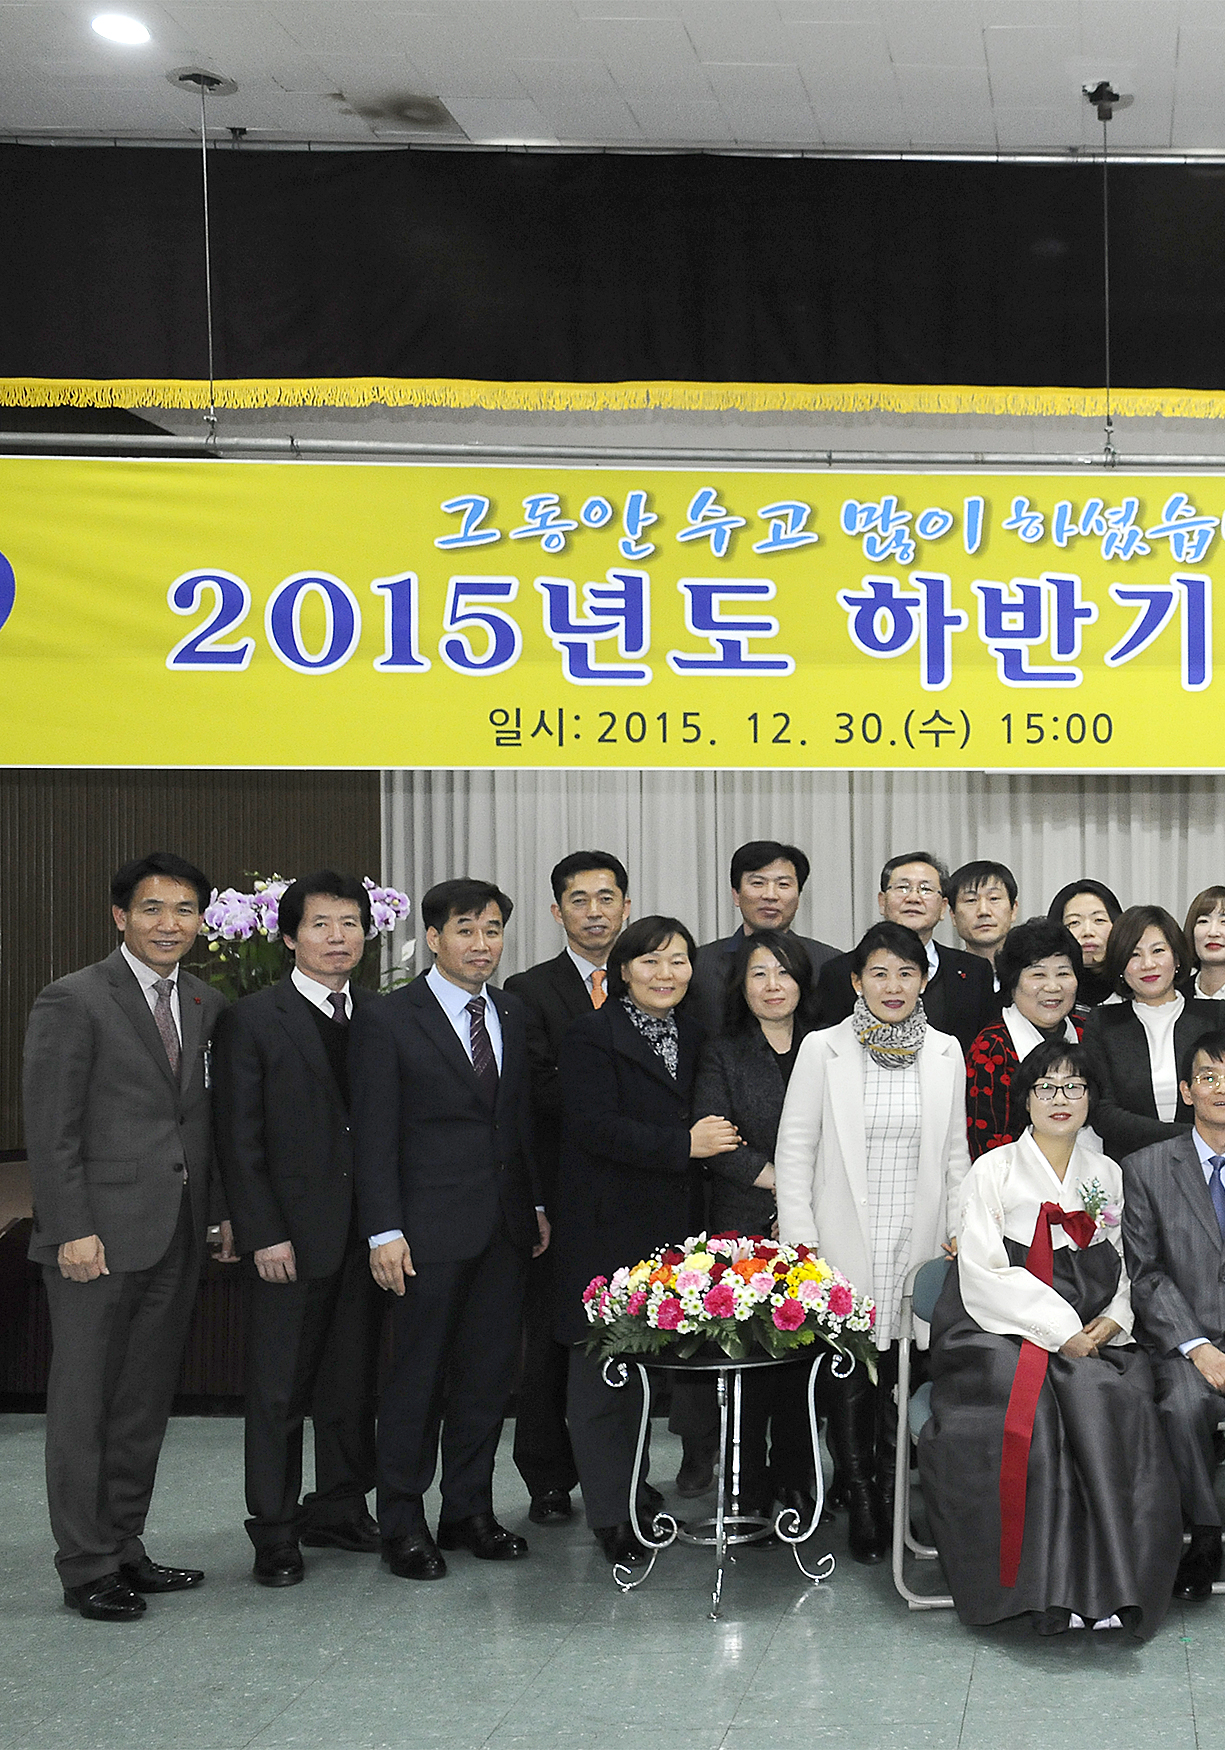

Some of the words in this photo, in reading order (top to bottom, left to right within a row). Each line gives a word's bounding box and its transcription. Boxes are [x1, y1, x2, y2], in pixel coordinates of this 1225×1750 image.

[436, 491, 655, 558] 그동안
[677, 489, 816, 556] 수고
[842, 497, 982, 563] 많이
[171, 572, 790, 681] 2015년도
[841, 575, 1207, 687] 하반기
[489, 707, 584, 748] 일시:
[597, 711, 717, 747] 2015.
[746, 712, 808, 747] 12.
[833, 709, 972, 750] 30.(수)
[1000, 712, 1114, 745] 15:00
